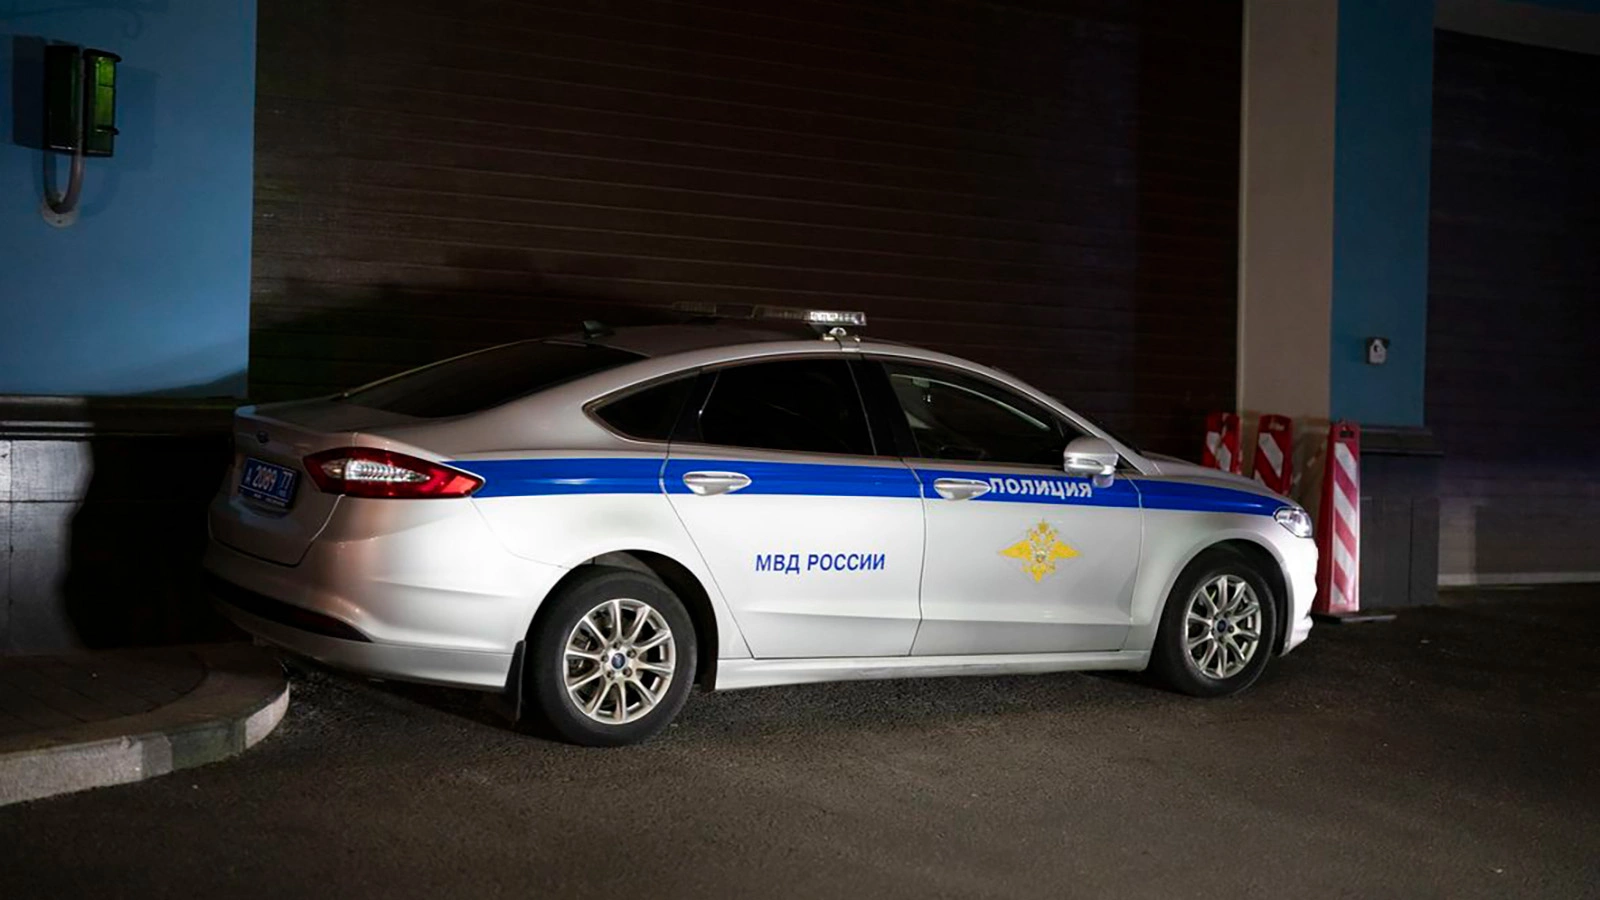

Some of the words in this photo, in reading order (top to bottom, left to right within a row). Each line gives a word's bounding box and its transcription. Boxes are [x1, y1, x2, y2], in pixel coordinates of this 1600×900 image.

[989, 478, 1093, 500] ПОЛИЦИЯ
[755, 554, 800, 574] МВД
[807, 553, 886, 571] РОССИИ
